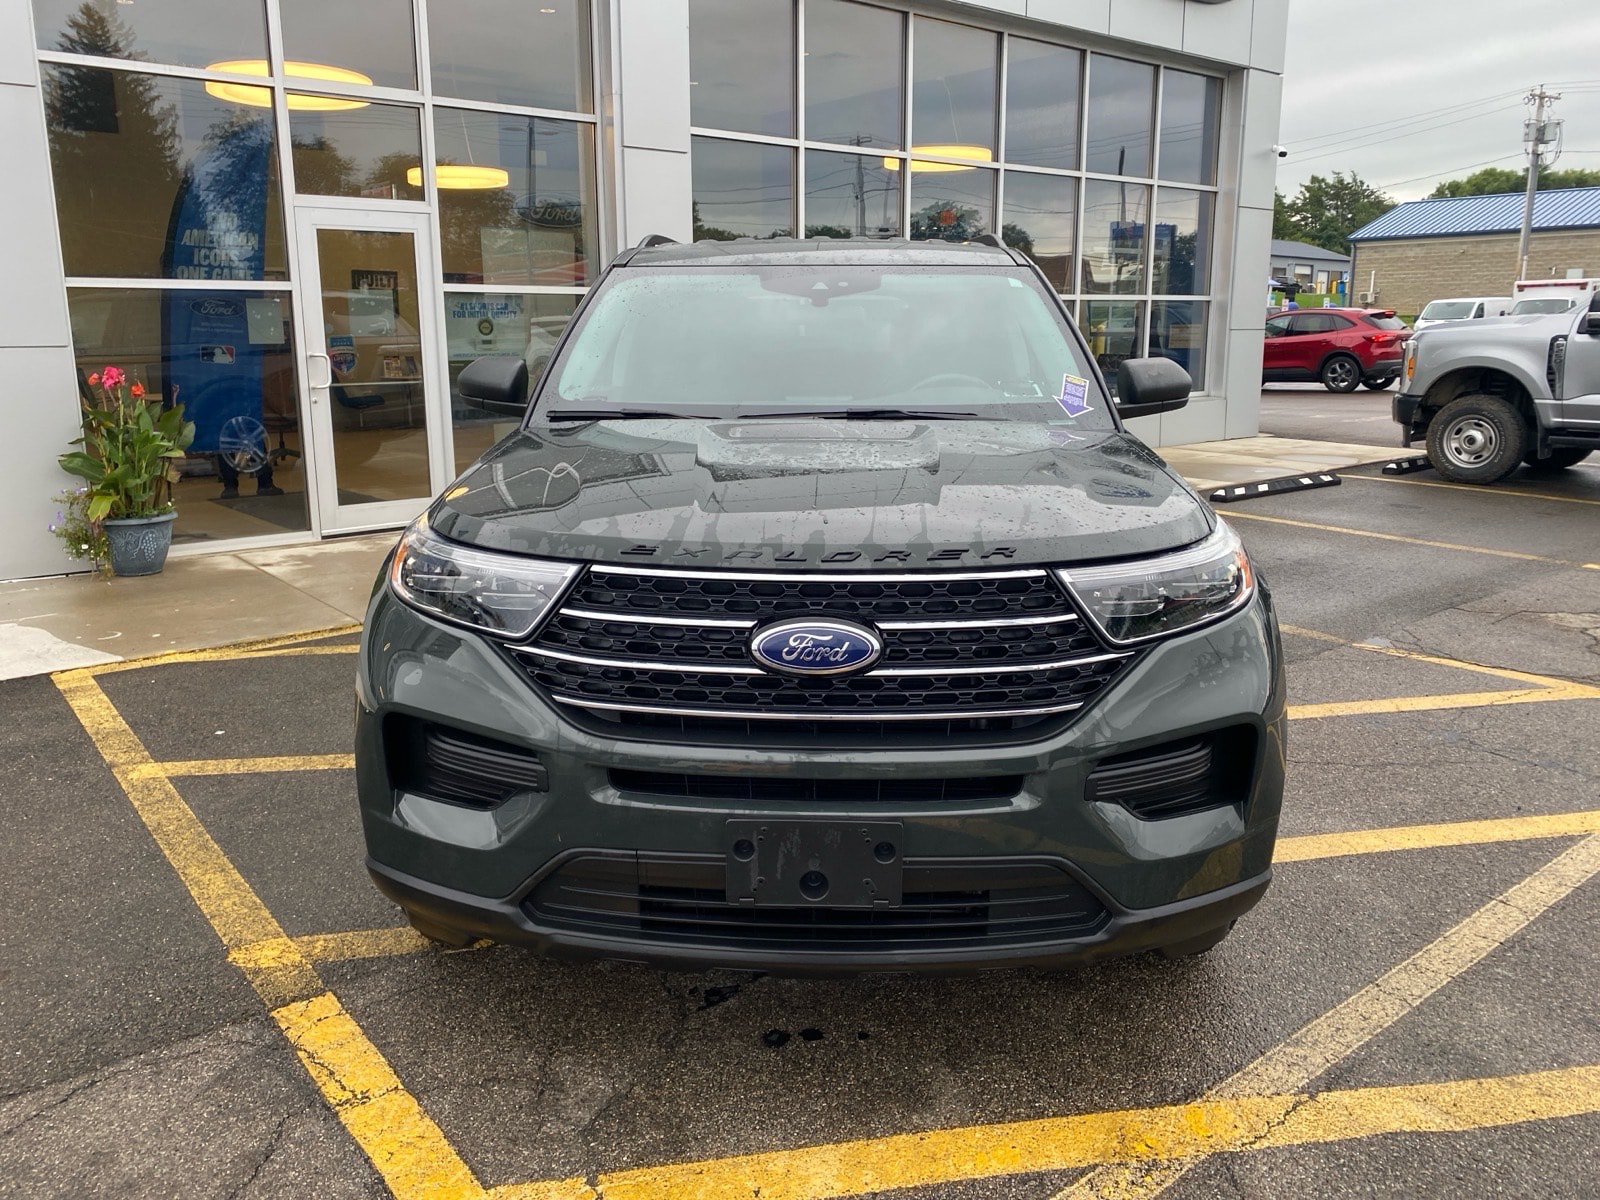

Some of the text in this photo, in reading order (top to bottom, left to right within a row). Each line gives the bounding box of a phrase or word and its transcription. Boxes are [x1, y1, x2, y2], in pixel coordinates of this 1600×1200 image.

[531, 198, 578, 221] Ford
[181, 229, 258, 250] AMERICAN
[193, 247, 238, 266] ICONS
[176, 265, 208, 280] ONE
[201, 300, 235, 315] Ford
[453, 310, 517, 320] FOR INITIAL QUALITY
[620, 544, 1018, 563] EXPLORER
[782, 633, 850, 662] Ford
